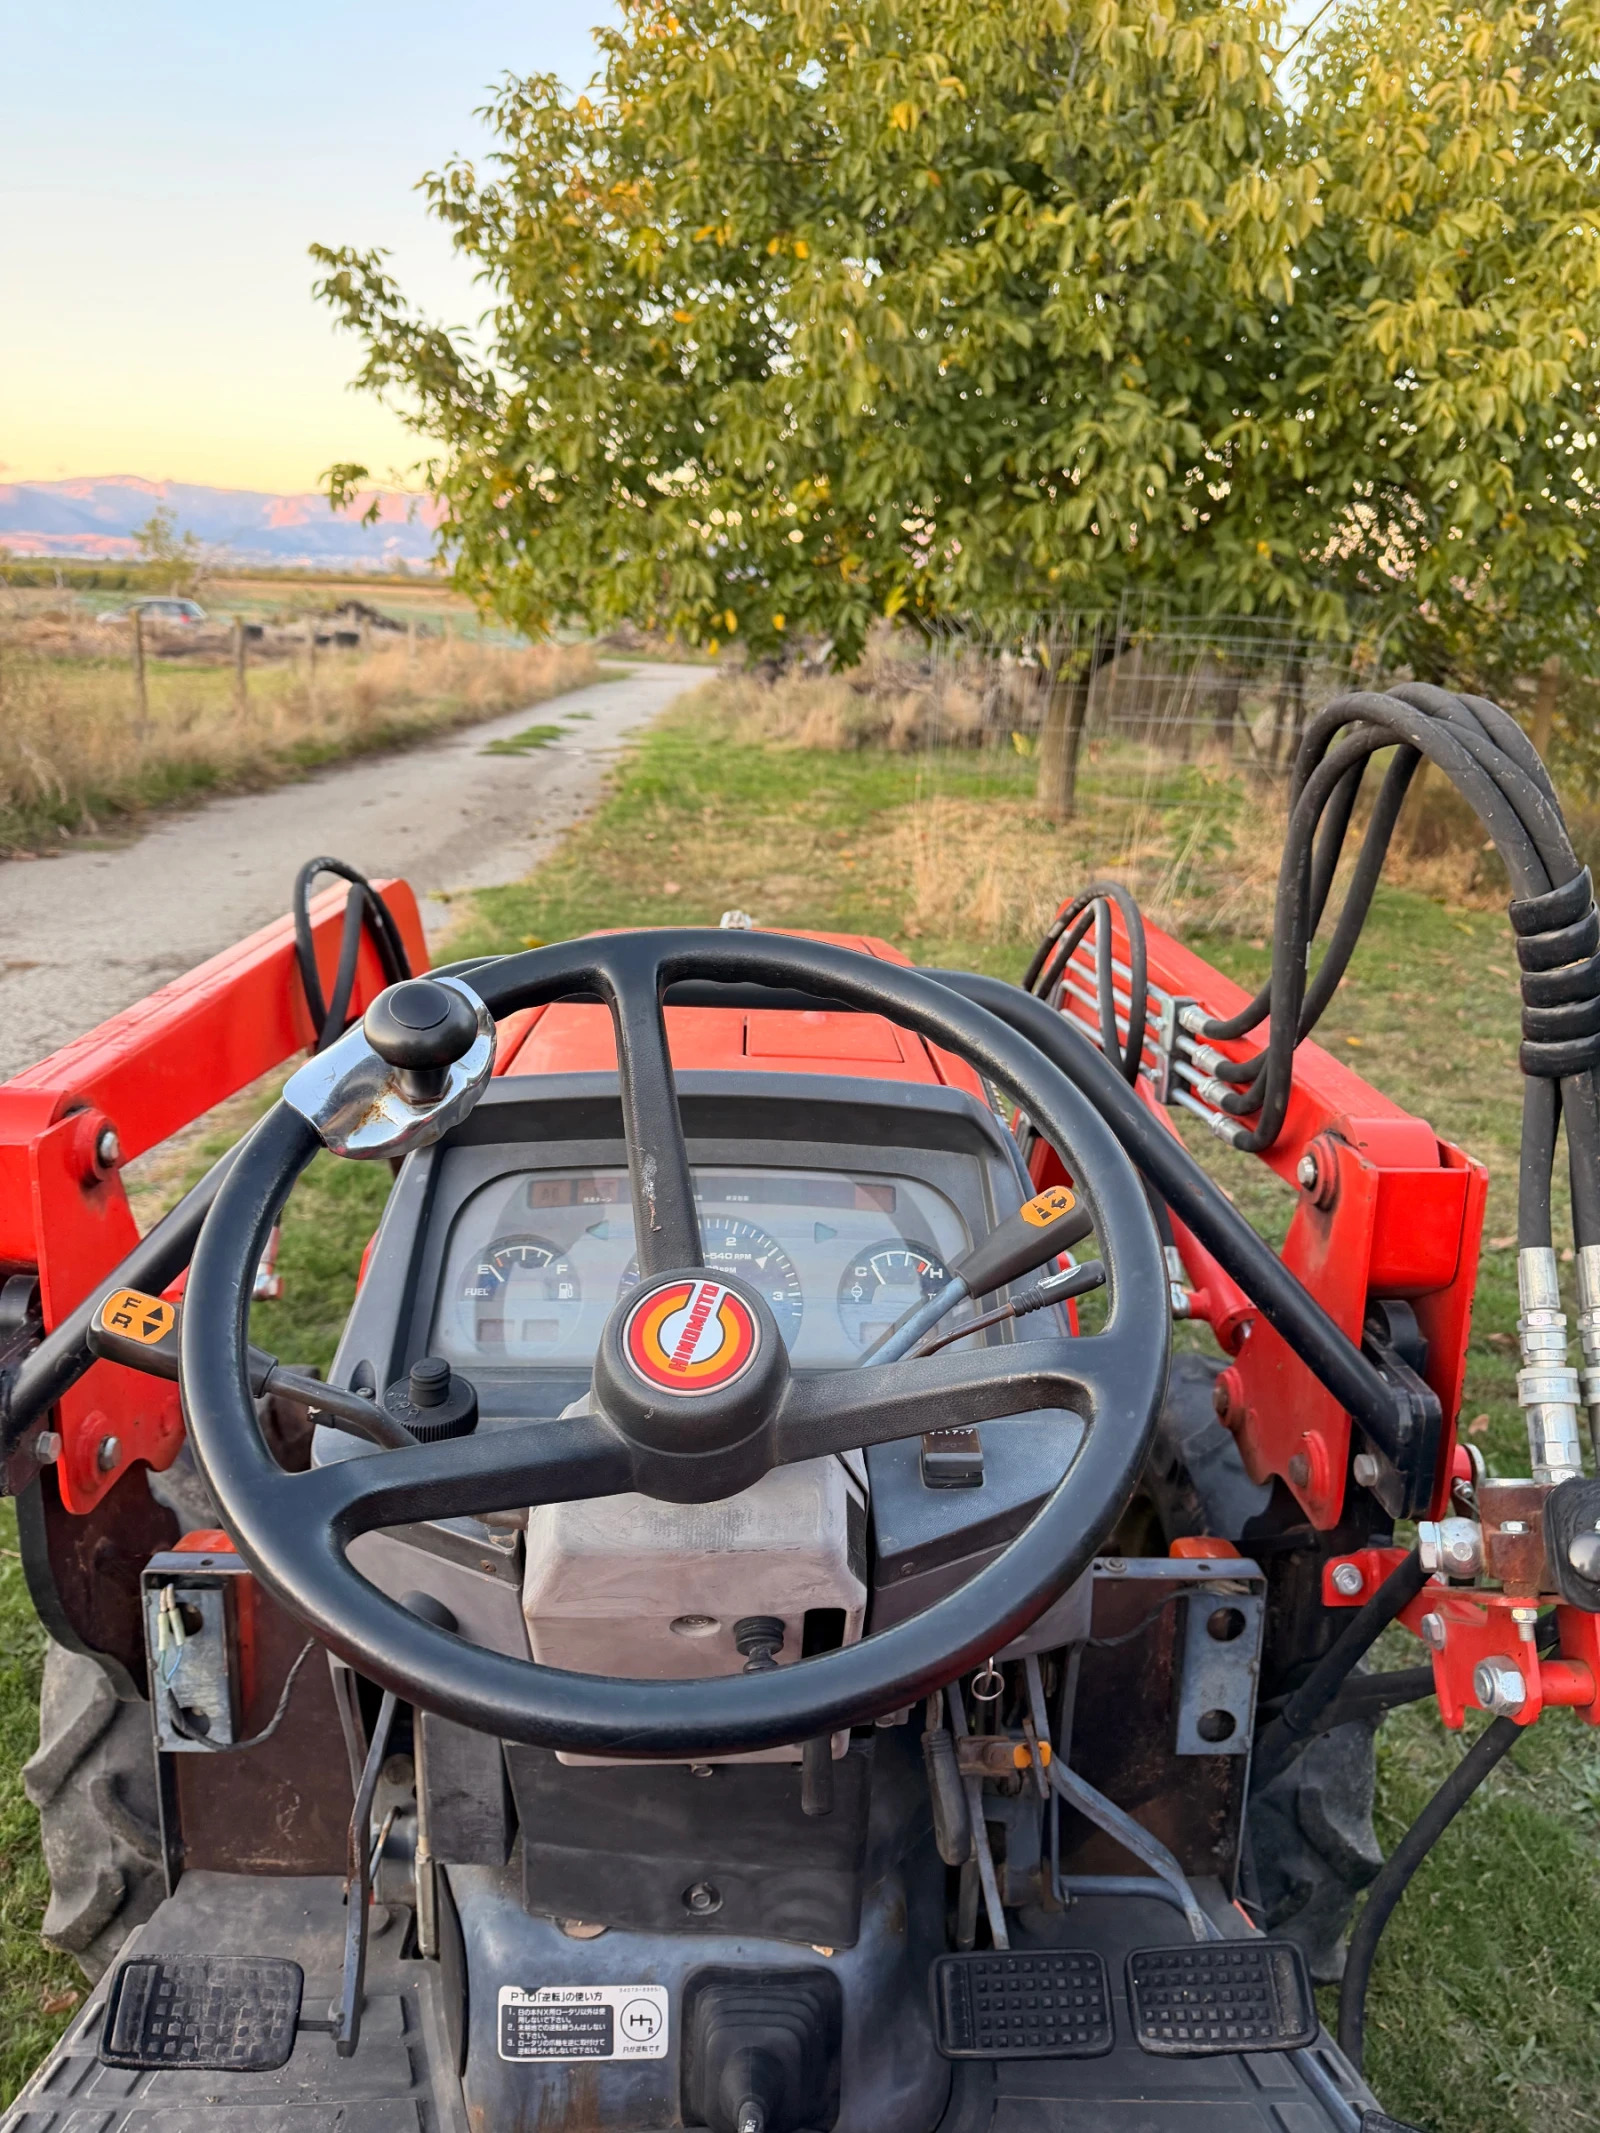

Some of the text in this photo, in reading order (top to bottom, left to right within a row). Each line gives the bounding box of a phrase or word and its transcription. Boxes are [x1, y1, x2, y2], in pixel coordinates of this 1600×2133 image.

[725, 1237, 737, 1246] 2
[477, 1264, 490, 1275] E
[556, 1264, 568, 1275] F
[854, 1266, 868, 1277] C
[929, 1268, 943, 1279] H
[464, 1288, 489, 1296] FUEL
[772, 1291, 784, 1301] 3
[122, 1296, 142, 1309] F
[111, 1312, 133, 1329] R
[668, 1283, 720, 1372] HINOMOTO
